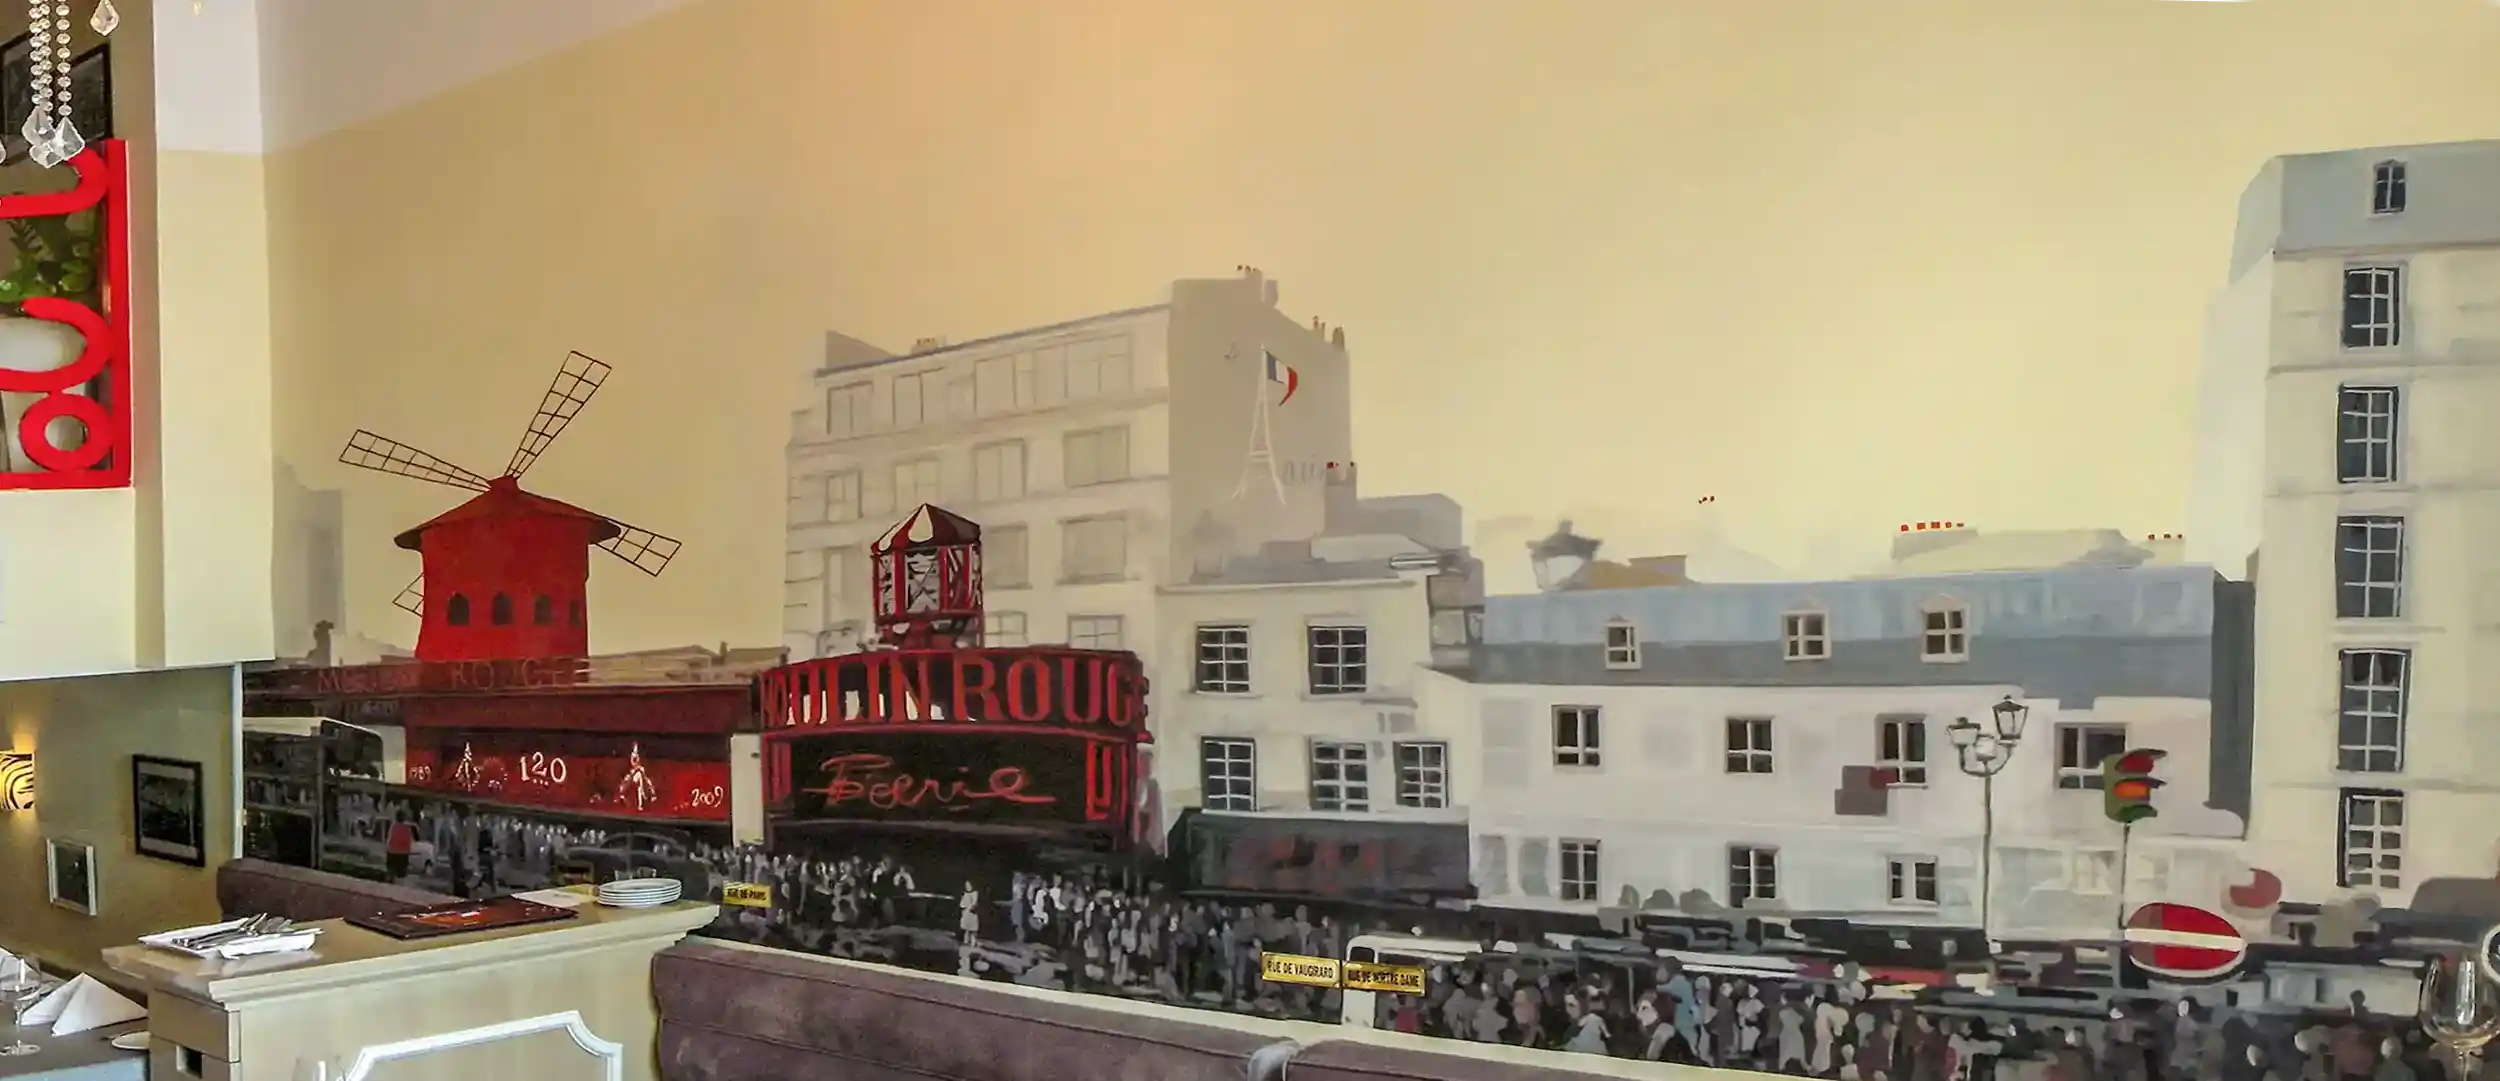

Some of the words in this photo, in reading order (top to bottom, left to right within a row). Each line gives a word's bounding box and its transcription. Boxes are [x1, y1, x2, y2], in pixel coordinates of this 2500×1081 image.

[519, 751, 567, 784] 120
[691, 785, 724, 808] 2009
[1266, 960, 1281, 973] RUE
[1283, 962, 1294, 975] DE
[1295, 964, 1334, 979] VAUGIRARD
